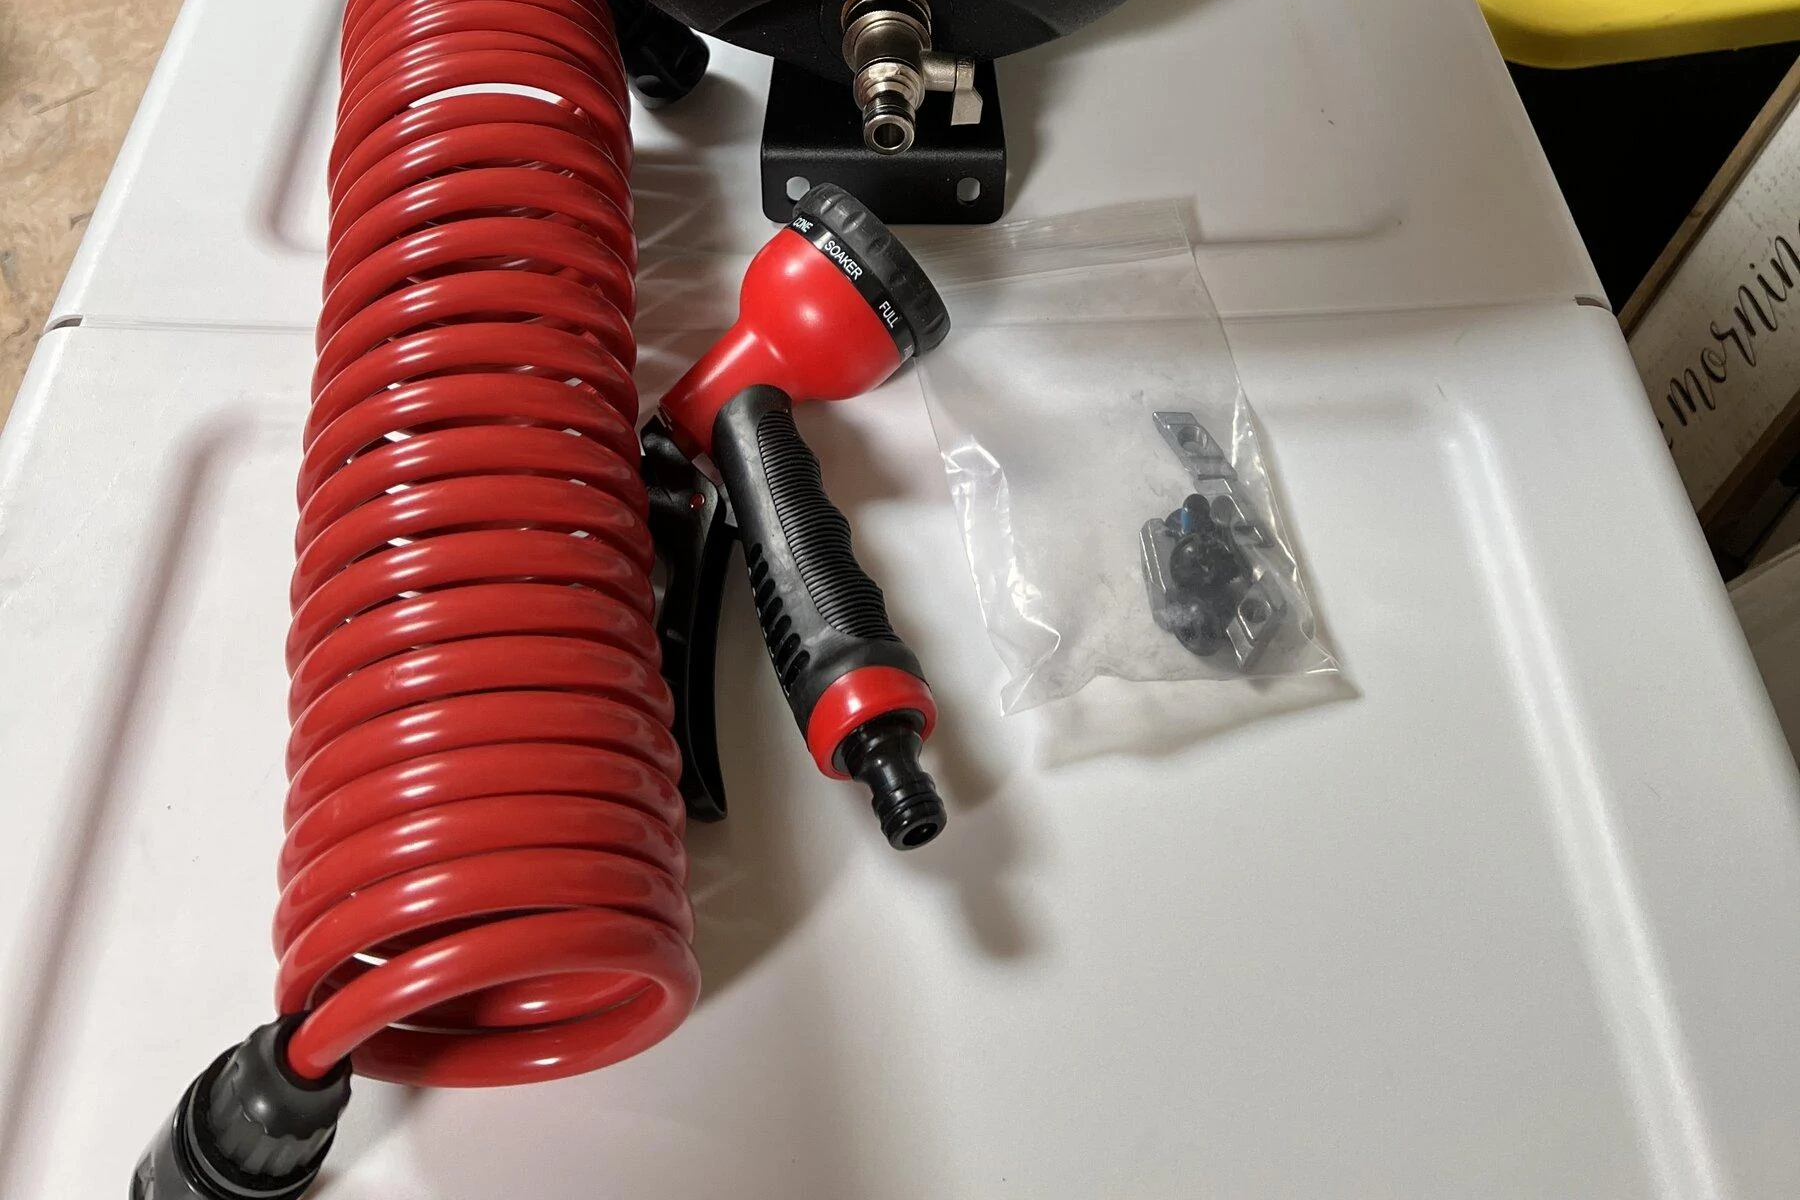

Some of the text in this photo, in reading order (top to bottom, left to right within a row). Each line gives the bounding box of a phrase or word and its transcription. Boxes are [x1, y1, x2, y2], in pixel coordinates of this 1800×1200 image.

[793, 217, 814, 233] CONE
[824, 240, 863, 280] SOAKER
[878, 301, 898, 329] FULL
[1666, 218, 1800, 426] mornin
